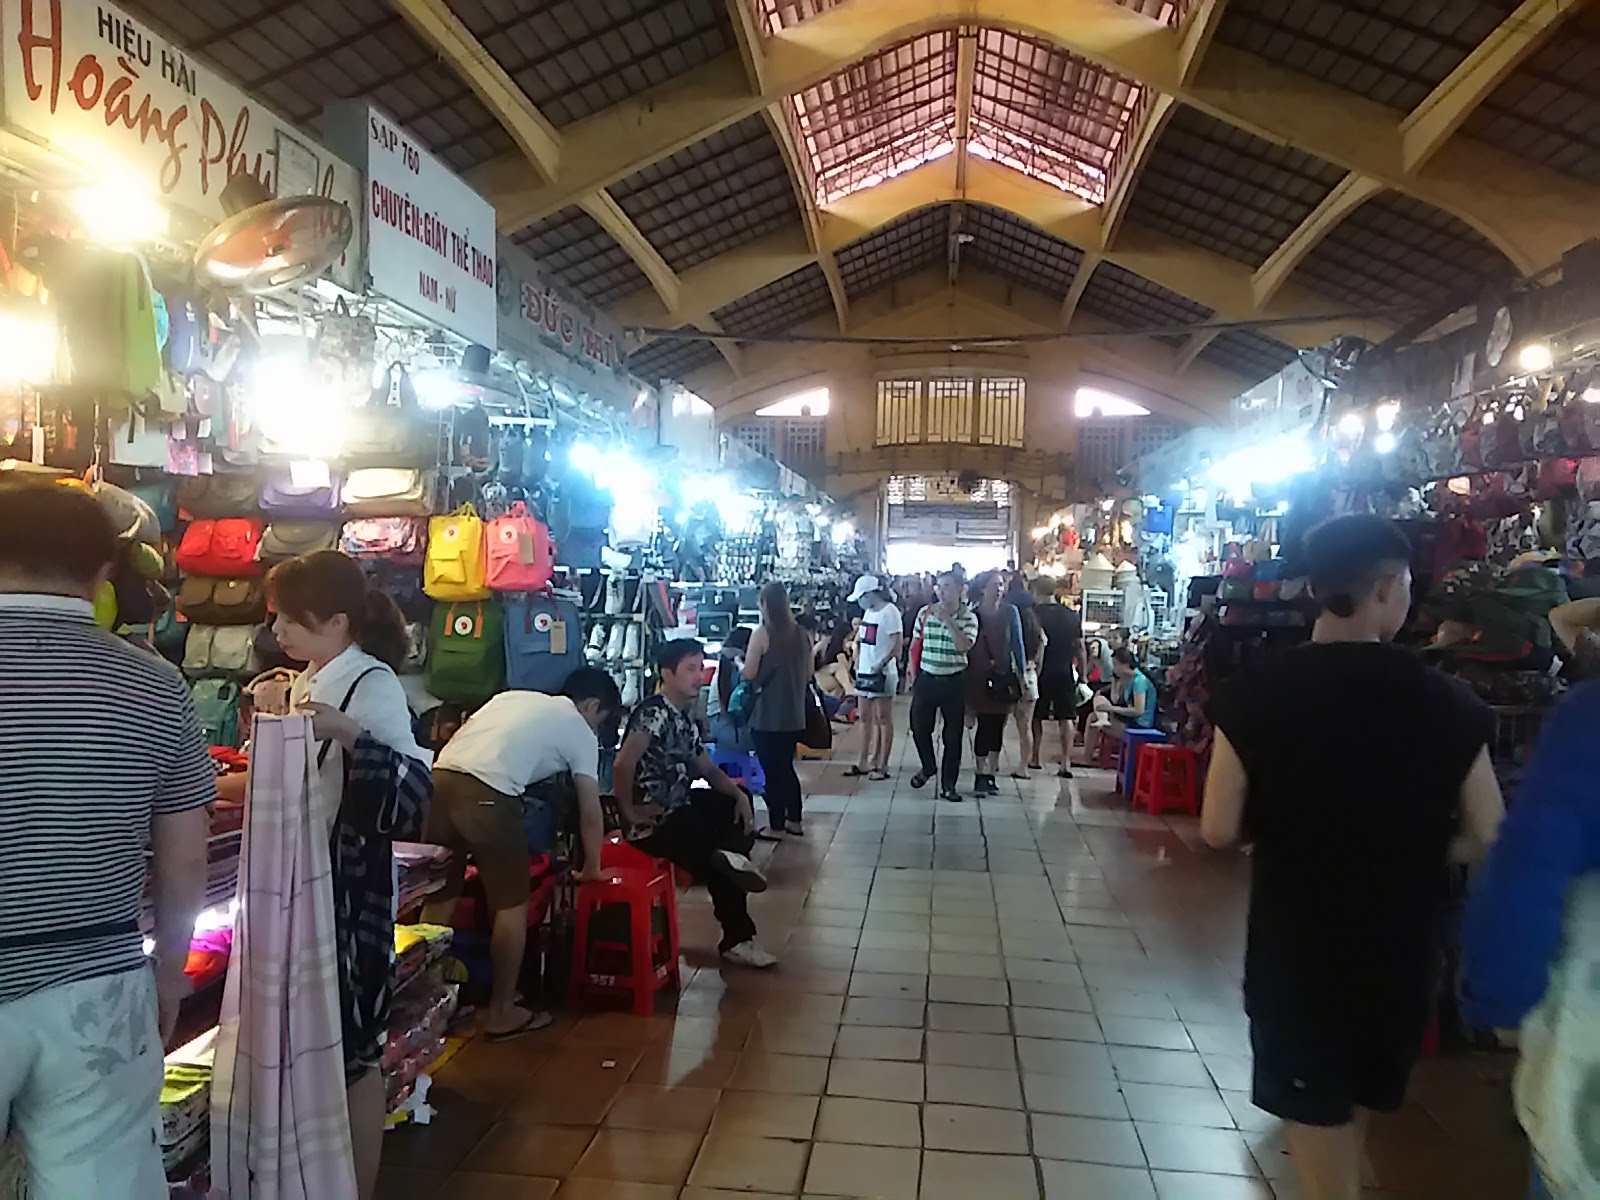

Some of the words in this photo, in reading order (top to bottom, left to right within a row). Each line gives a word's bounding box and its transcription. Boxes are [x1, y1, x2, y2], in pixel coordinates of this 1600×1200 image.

[97, 6, 151, 67] HIỆU
[161, 50, 196, 96] HÀI
[17, 0, 188, 194] Hoàng
[402, 141, 420, 175] 760
[419, 271, 438, 304] NAM
